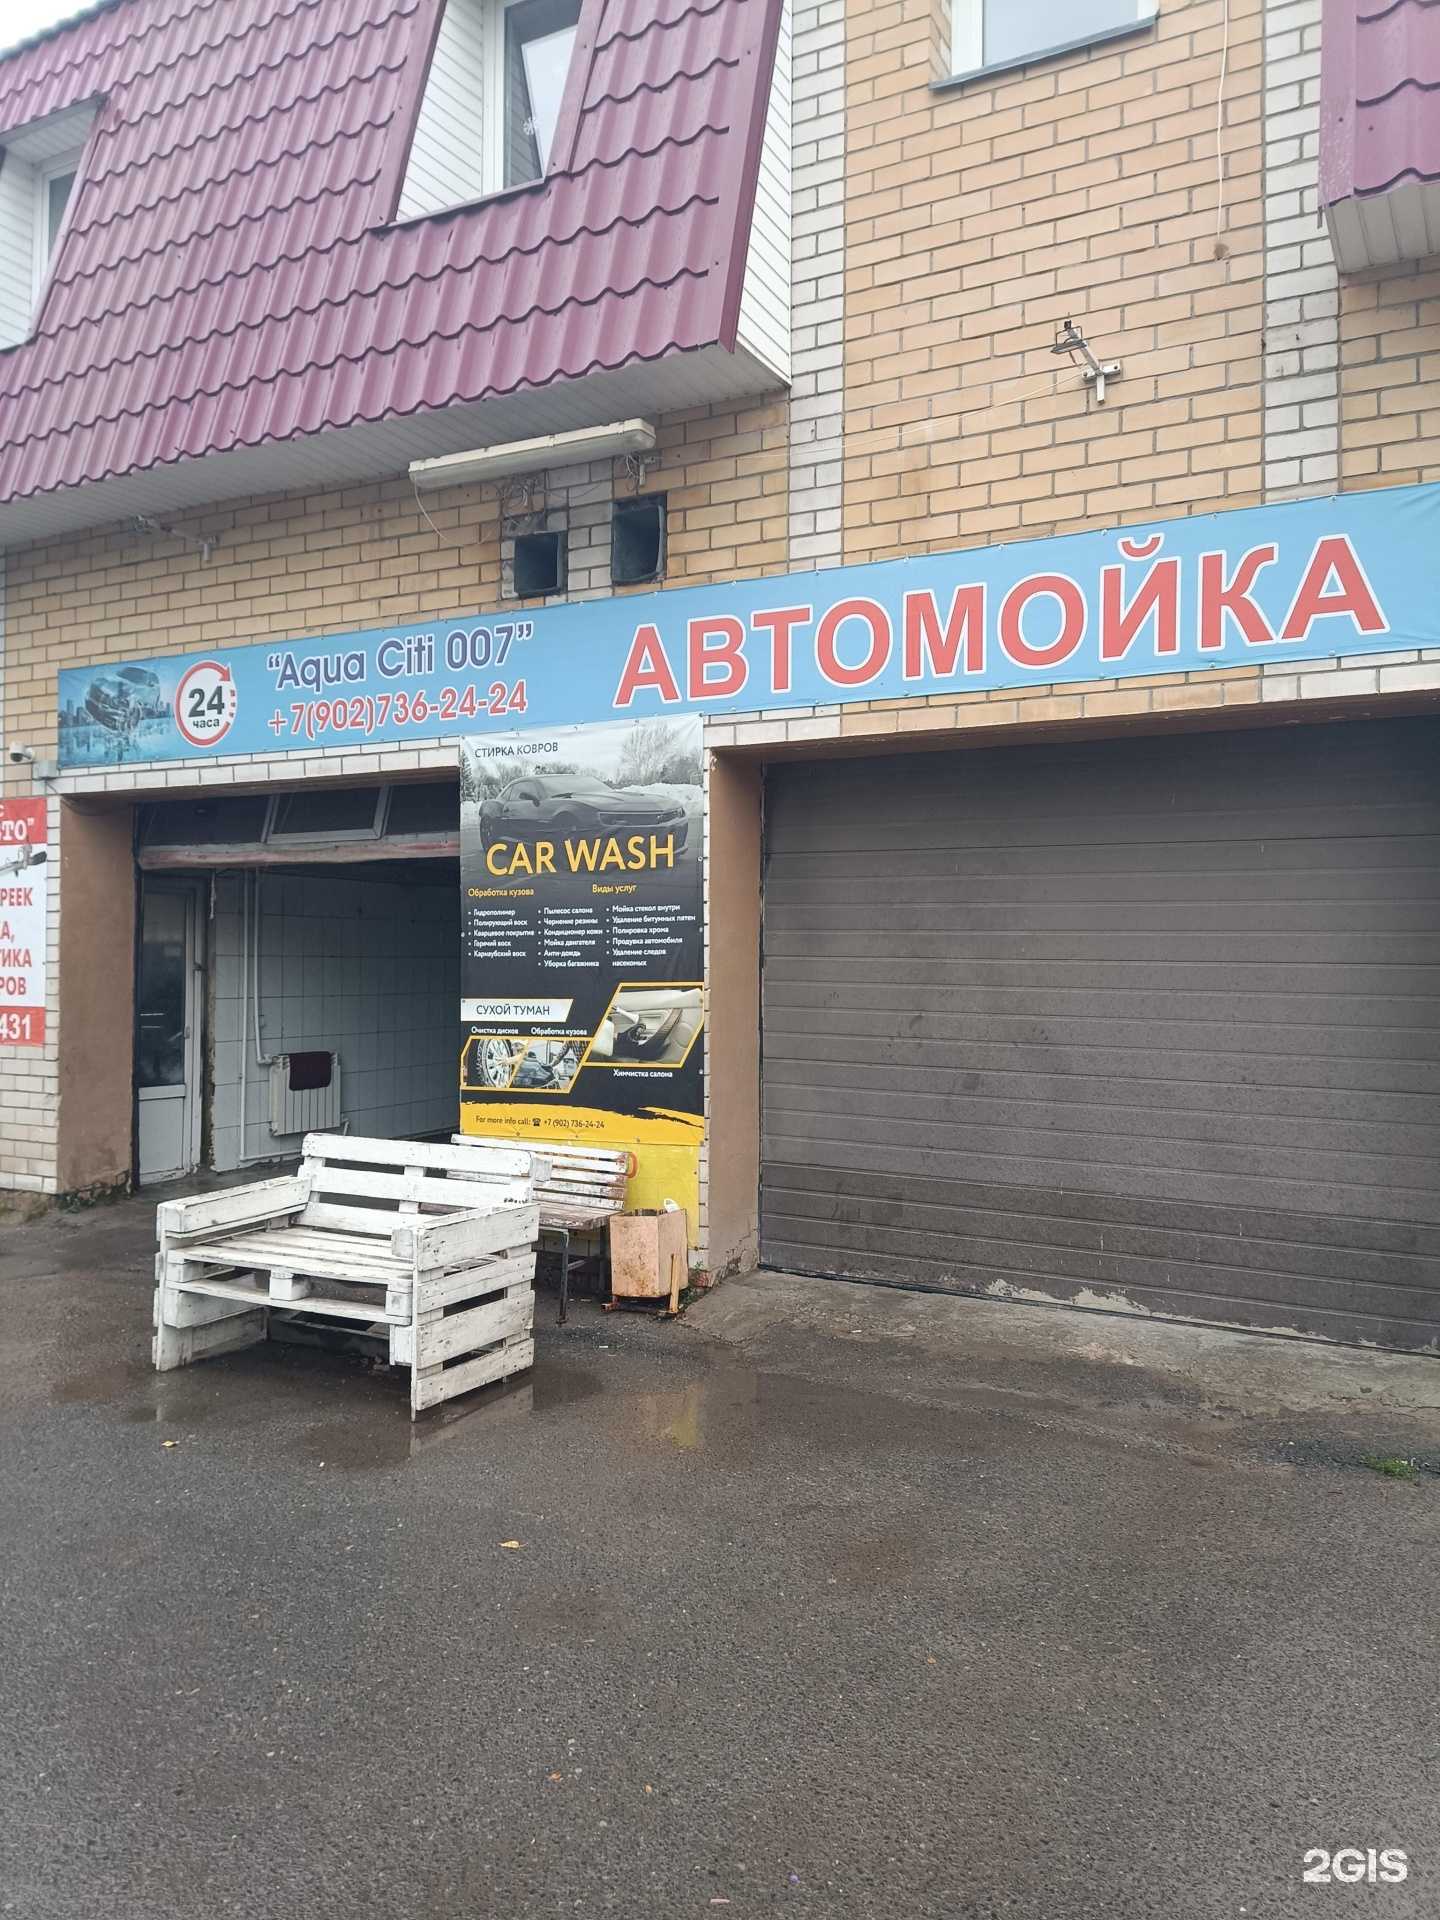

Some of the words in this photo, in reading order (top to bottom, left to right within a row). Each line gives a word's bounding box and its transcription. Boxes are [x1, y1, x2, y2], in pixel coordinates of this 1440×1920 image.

[613, 534, 1390, 707] АВТОМОЙКА
[378, 636, 433, 676] Citi
[189, 686, 224, 718] 24
[268, 680, 527, 738] +7(902)736-24-24
[193, 717, 220, 729] часа
[475, 745, 514, 758] СТИРКА
[517, 742, 558, 756] КОВРОВ
[0, 818, 34, 841] ТО"
[486, 841, 556, 876] CAR
[564, 834, 674, 873] WASH
[468, 888, 507, 898] Обработка
[508, 888, 534, 898] кузова
[592, 884, 614, 894] Виды
[615, 884, 637, 894] услуг
[0, 921, 15, 943] А,
[612, 927, 648, 935] Полировка
[612, 948, 642, 956] Удаление
[544, 960, 566, 968] Уборка
[476, 1002, 512, 1015] СУХОЙ
[514, 1006, 550, 1015] ТУМАН
[471, 1026, 495, 1034] Очистка
[531, 1026, 565, 1036] Обработка
[565, 1028, 588, 1036] кузова
[613, 1069, 648, 1078] Химчистка
[649, 1070, 673, 1078] салона
[476, 1116, 485, 1124] For
[507, 1116, 516, 1125] info
[518, 1117, 531, 1125] call:
[544, 1119, 552, 1127] +7
[553, 1120, 570, 1128] (902)
[571, 1120, 605, 1129] 736-24-24
